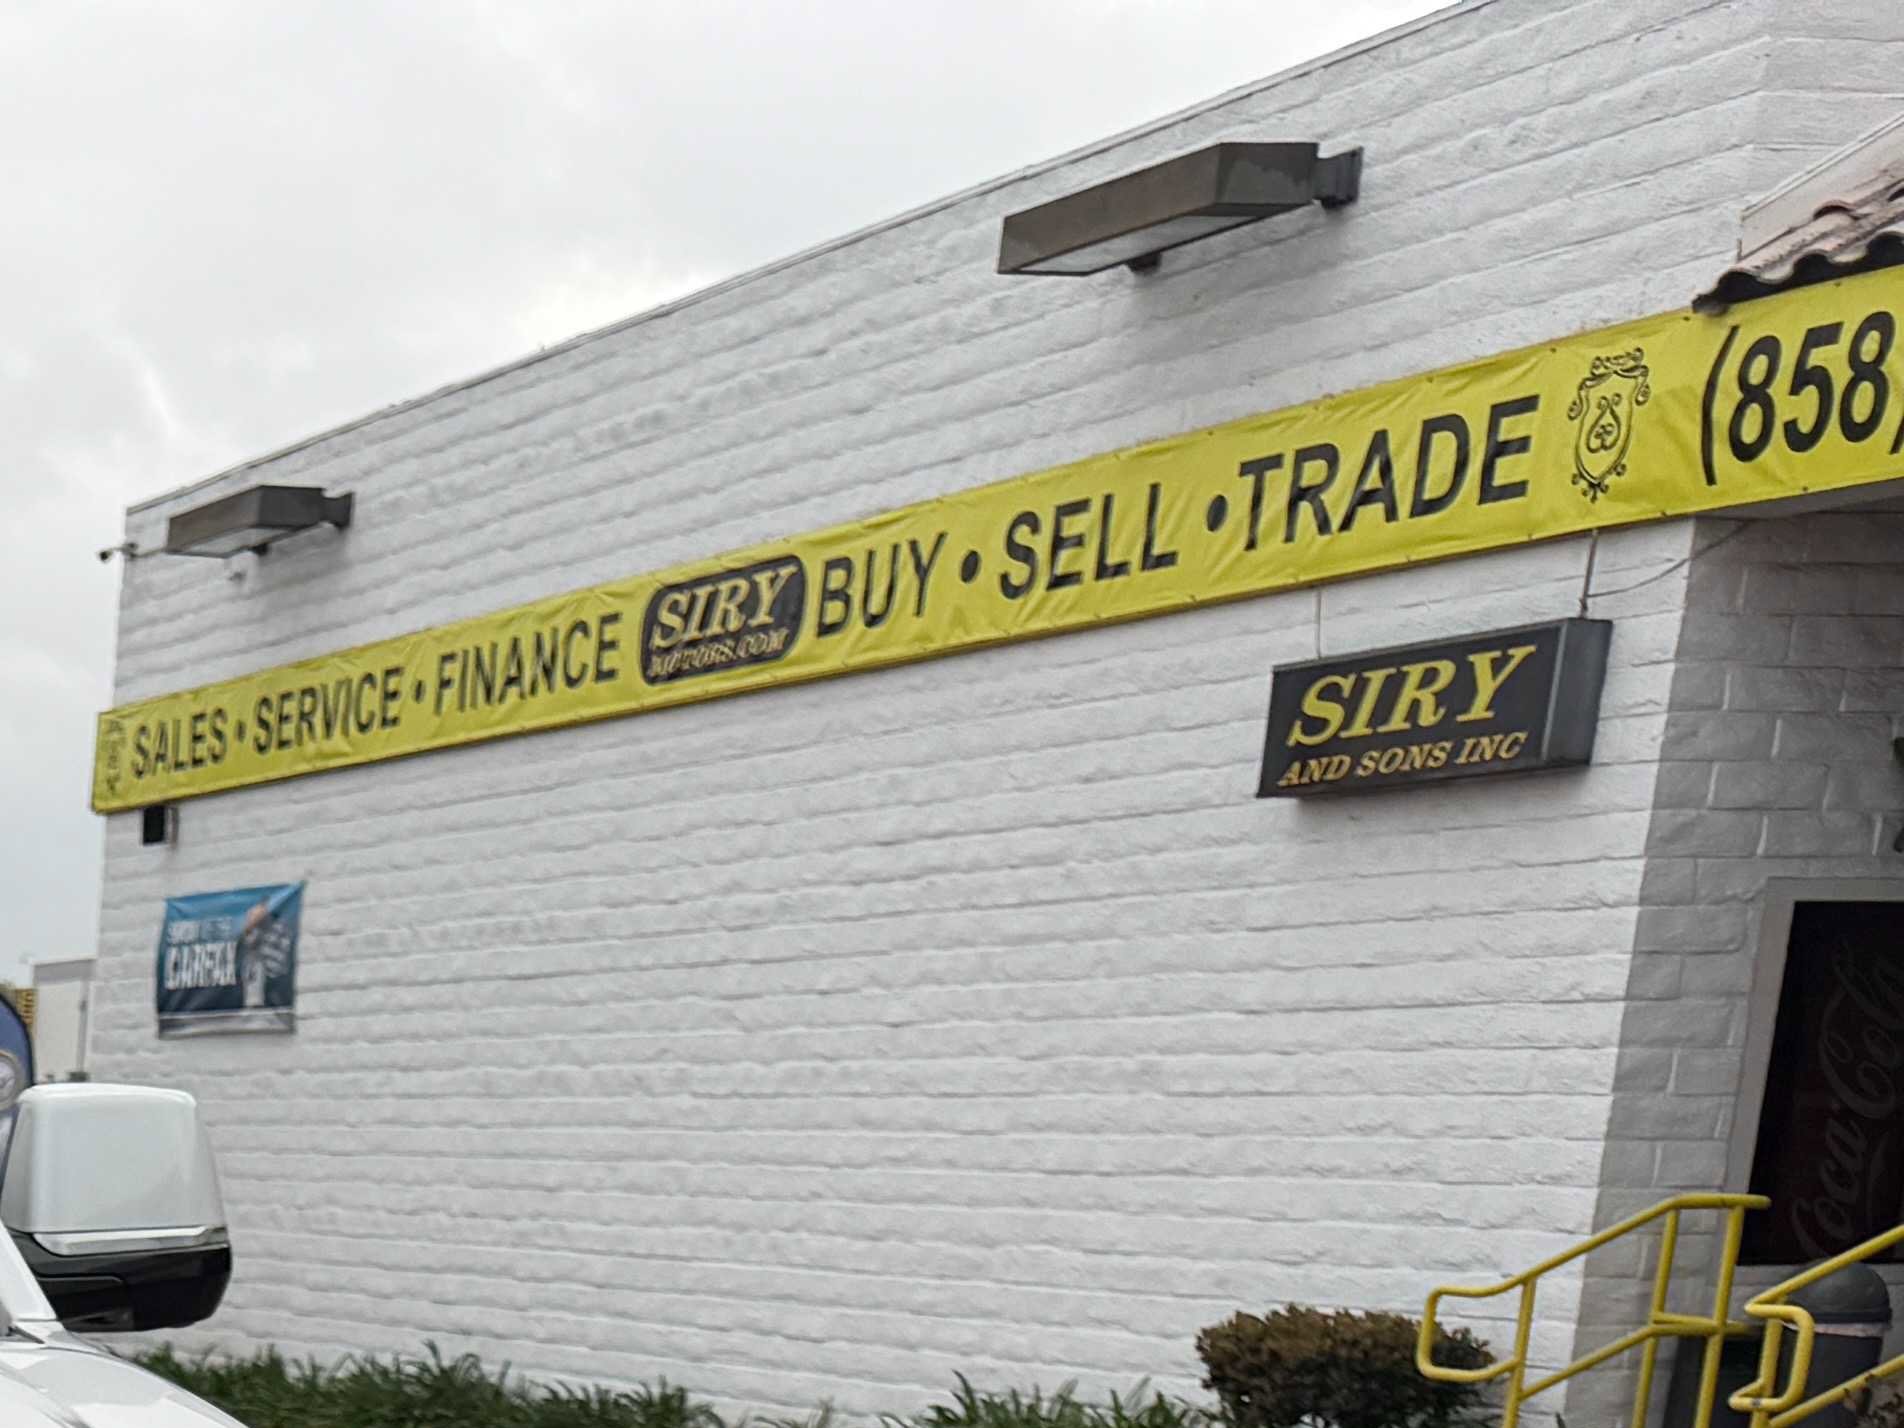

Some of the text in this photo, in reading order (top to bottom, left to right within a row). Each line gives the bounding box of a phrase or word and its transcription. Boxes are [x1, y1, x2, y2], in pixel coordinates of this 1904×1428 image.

[1700, 310, 1904, 487] (858
[816, 394, 1541, 640] BUY SELL TRADE
[646, 627, 790, 677] MOTORS.COM
[649, 564, 800, 648] SIRY
[131, 612, 621, 780] SALES SERVICE FINANCE
[1285, 644, 1537, 747] SIRY
[1277, 731, 1529, 787] AND SONS INC
